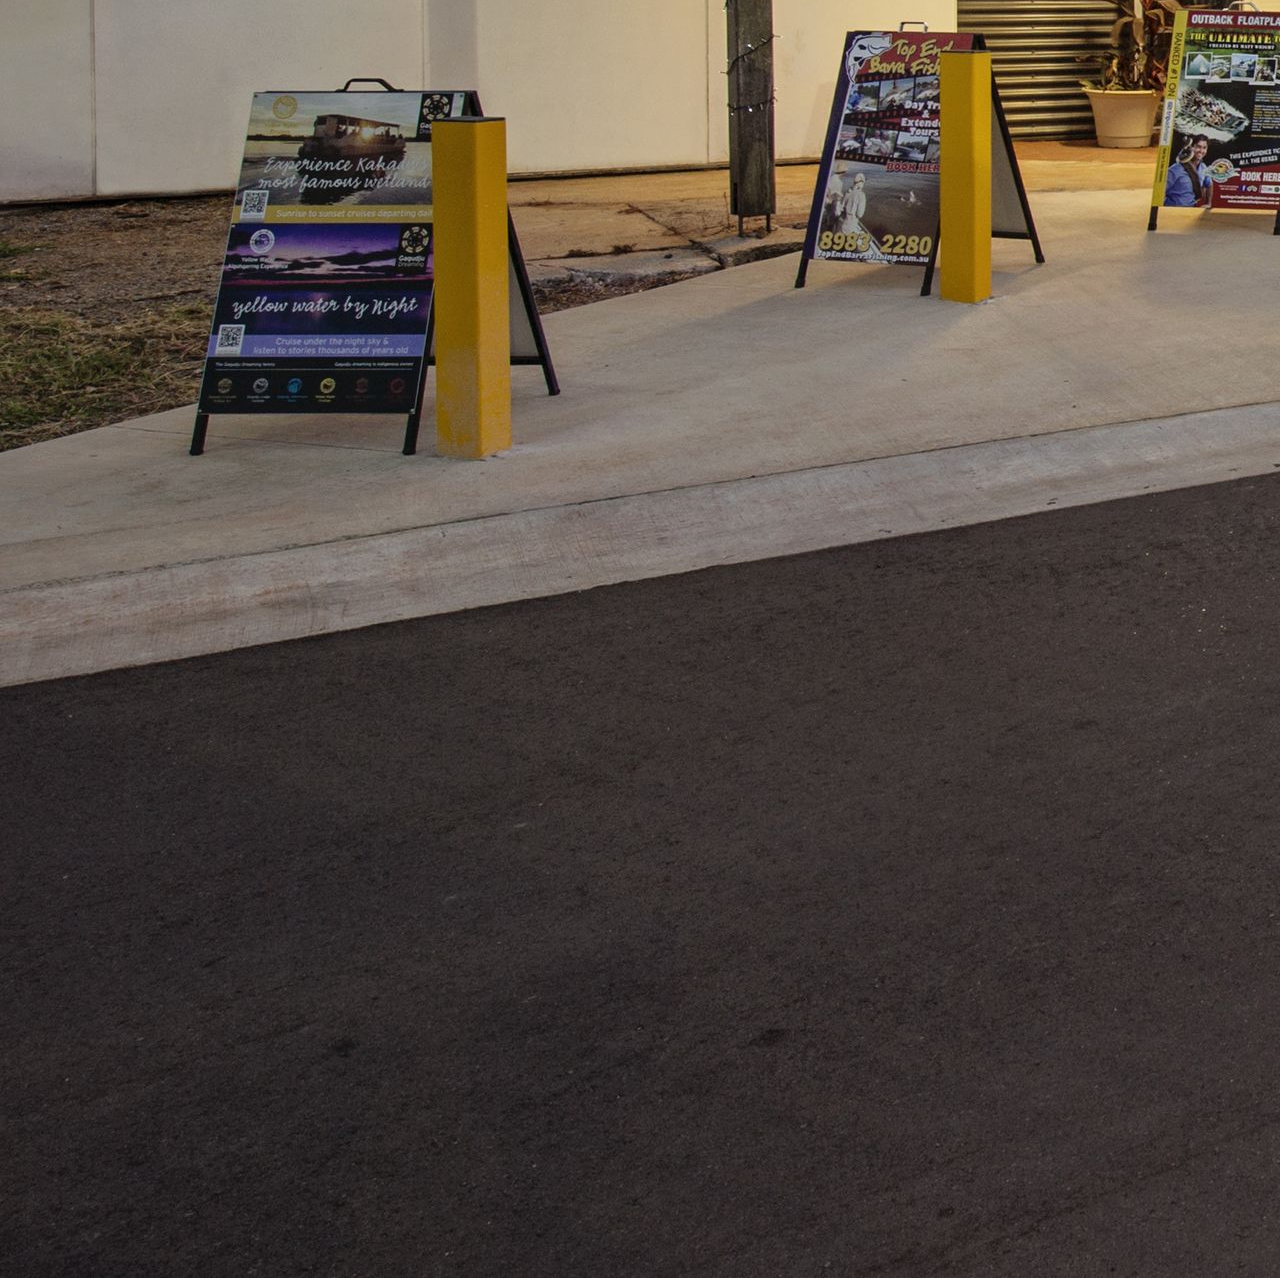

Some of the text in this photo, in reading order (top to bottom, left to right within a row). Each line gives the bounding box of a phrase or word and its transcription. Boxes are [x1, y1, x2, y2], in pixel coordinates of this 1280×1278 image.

[1191, 14, 1234, 25] OUTBACK
[1190, 33, 1206, 41] THE
[1209, 33, 1272, 43] ULTIMATE
[893, 38, 917, 62] Top
[1171, 32, 1184, 66] RANKED
[868, 56, 940, 75] Barra Fish
[1167, 82, 1177, 97] ON
[904, 101, 924, 111] Day
[921, 110, 930, 118] &
[901, 118, 941, 127] Extend
[909, 127, 939, 136] Tours
[264, 156, 353, 176] Experience
[885, 162, 917, 173] BOOK
[1241, 171, 1261, 182] BOOK
[258, 174, 299, 189] most
[299, 174, 361, 193] famous
[276, 209, 307, 218] Sunrise
[308, 210, 317, 218] to
[318, 210, 346, 218] sunset
[348, 210, 375, 218] cruises
[377, 209, 416, 220] departing
[819, 230, 932, 255] 8983 2280
[232, 295, 287, 320] yellow
[292, 296, 339, 313] water
[344, 295, 369, 320] by
[276, 337, 301, 346] Cruise
[303, 337, 327, 346] under
[329, 337, 342, 346] the
[344, 337, 365, 348] night
[367, 337, 381, 348] sky
[253, 346, 409, 357] listen to stories thousands of years old
